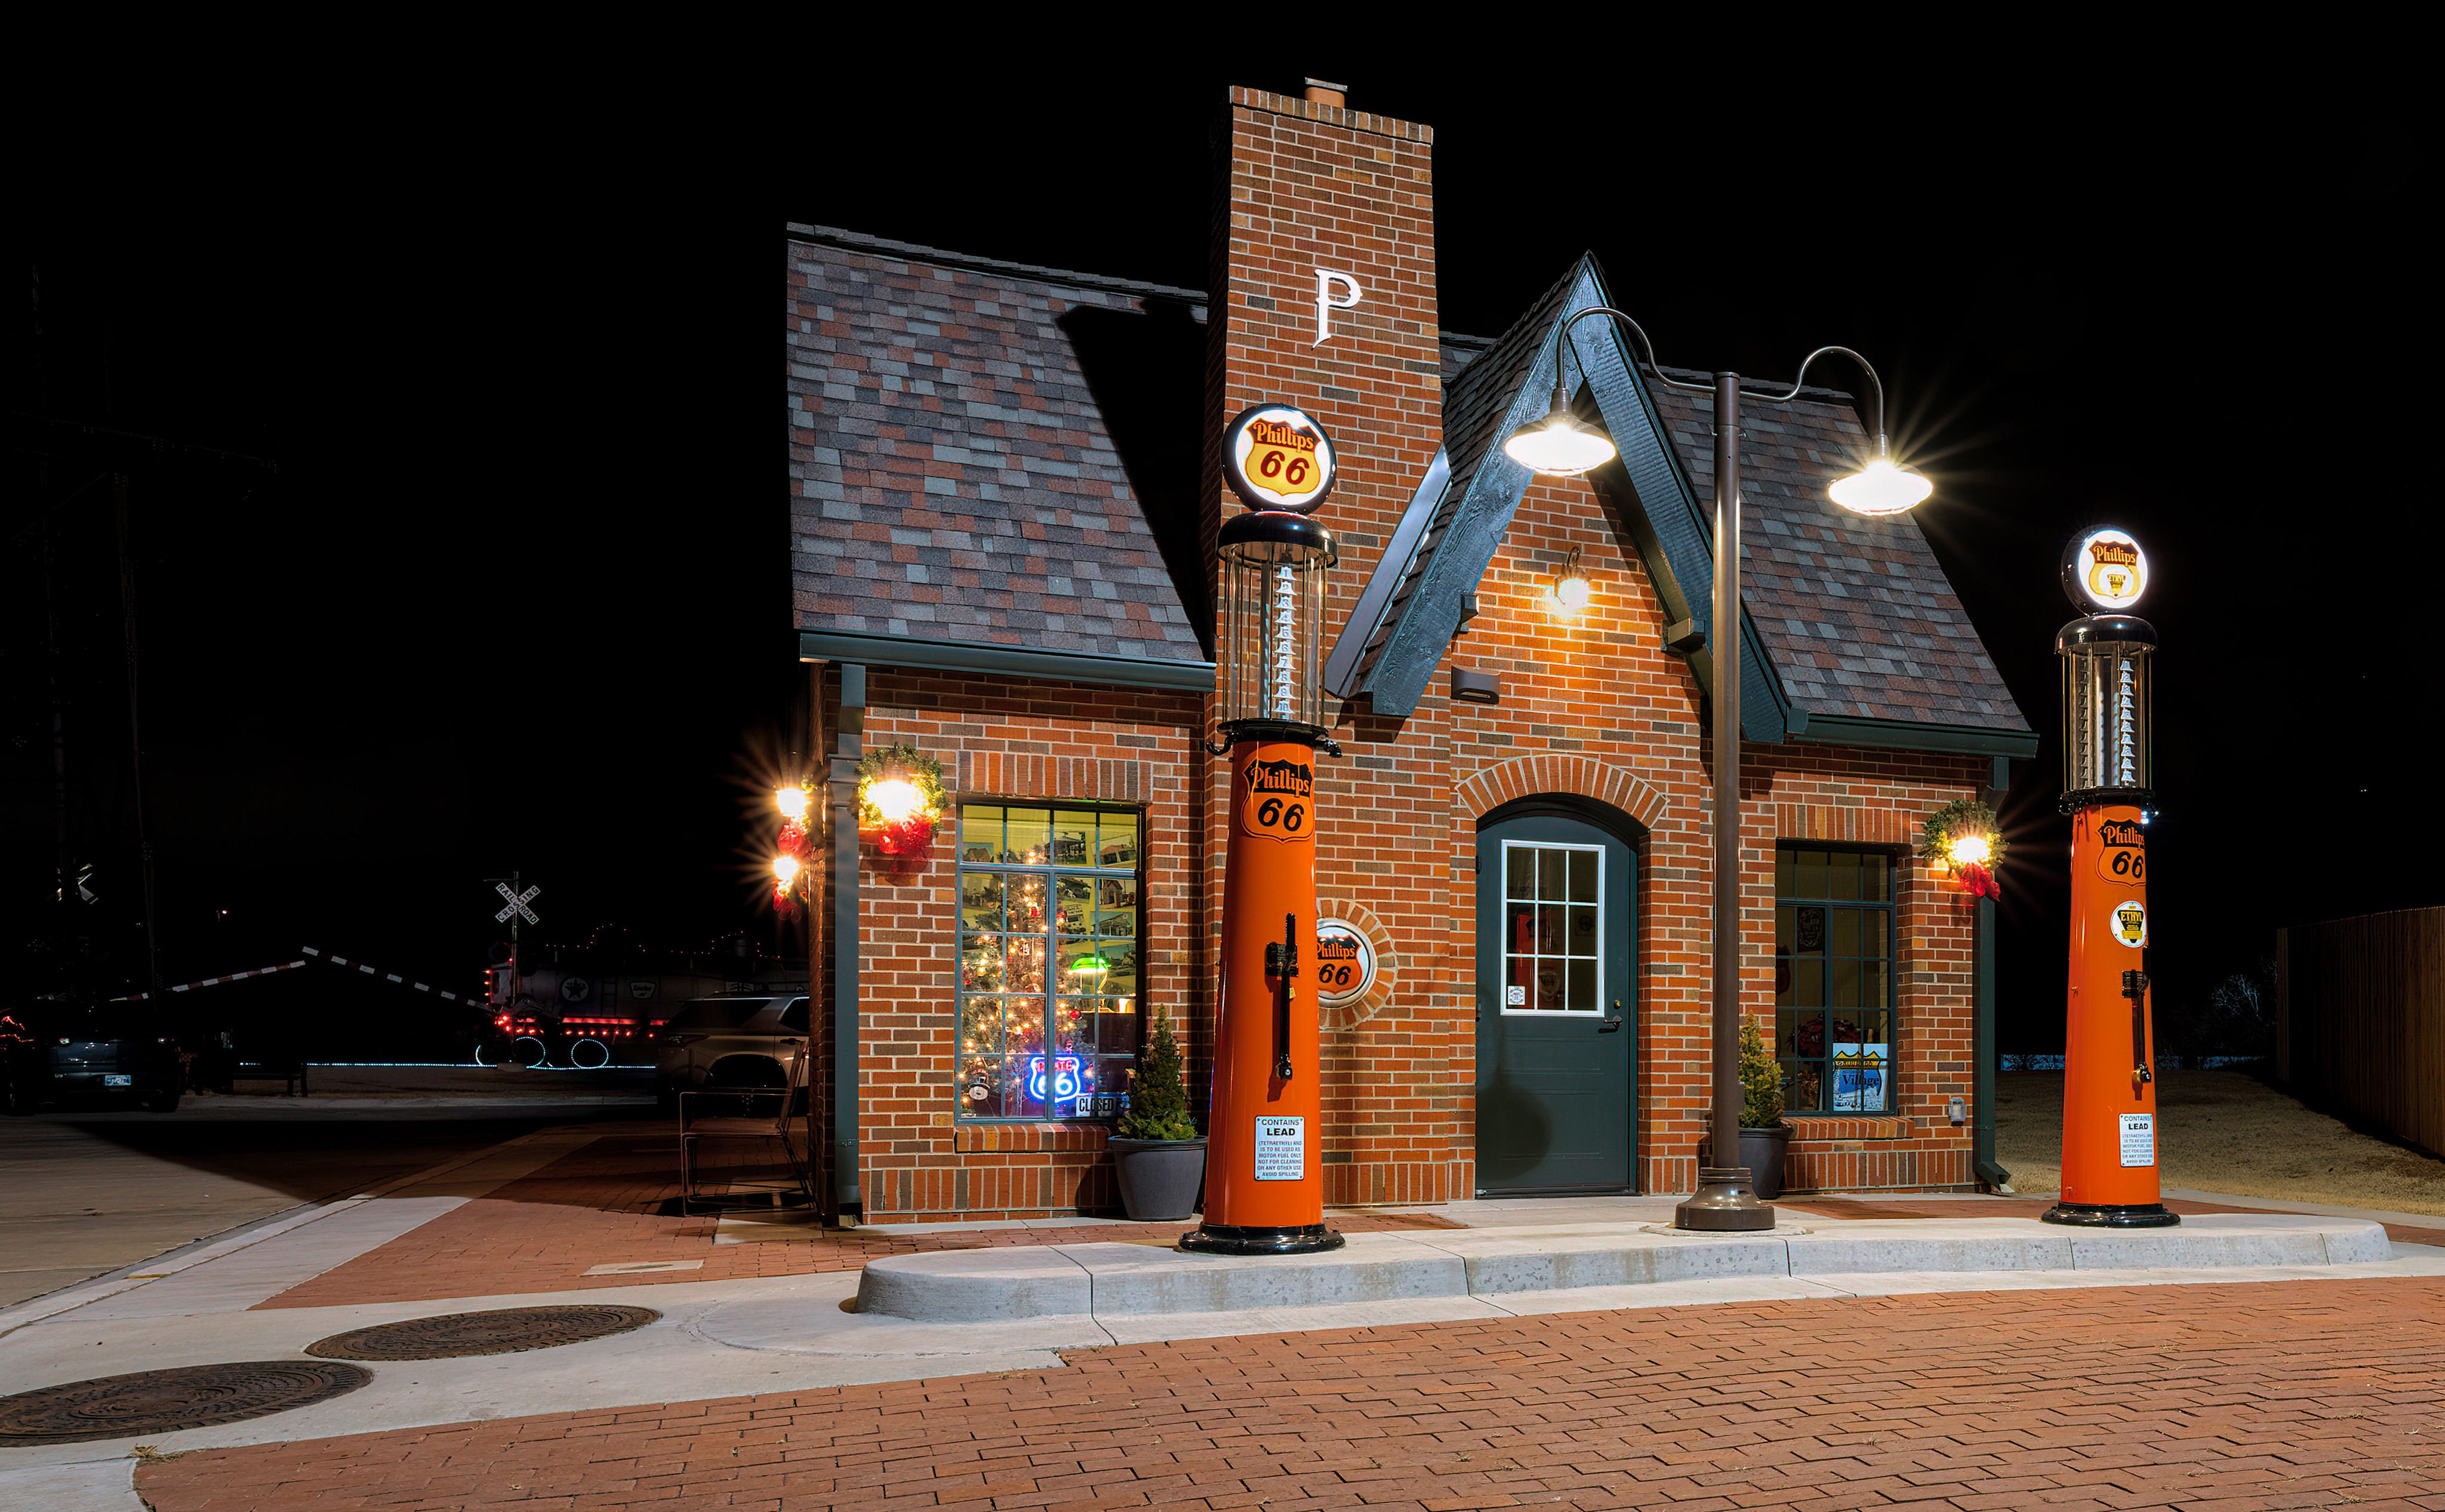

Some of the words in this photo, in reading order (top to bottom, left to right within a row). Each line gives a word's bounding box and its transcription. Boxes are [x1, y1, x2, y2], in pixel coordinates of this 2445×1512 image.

[1313, 269, 1363, 348] P
[1253, 421, 1313, 452] Phillips
[1260, 451, 1310, 485] 66
[2093, 545, 2136, 567] Phillips
[1281, 614, 1289, 622] 4
[1282, 628, 1289, 638] 5
[1282, 643, 1289, 652] 6
[1281, 658, 1287, 667] 7
[1281, 688, 1286, 696] 9
[1280, 702, 1289, 711] 10
[1250, 767, 1309, 797] Phillips
[1258, 798, 1304, 832] 66
[2112, 851, 2144, 879] 66
[2120, 911, 2142, 922] ETHYL
[1319, 963, 1351, 986] 66
[1079, 1098, 1114, 1112] CLOSED
[1267, 1128, 1296, 1136] LEAD
